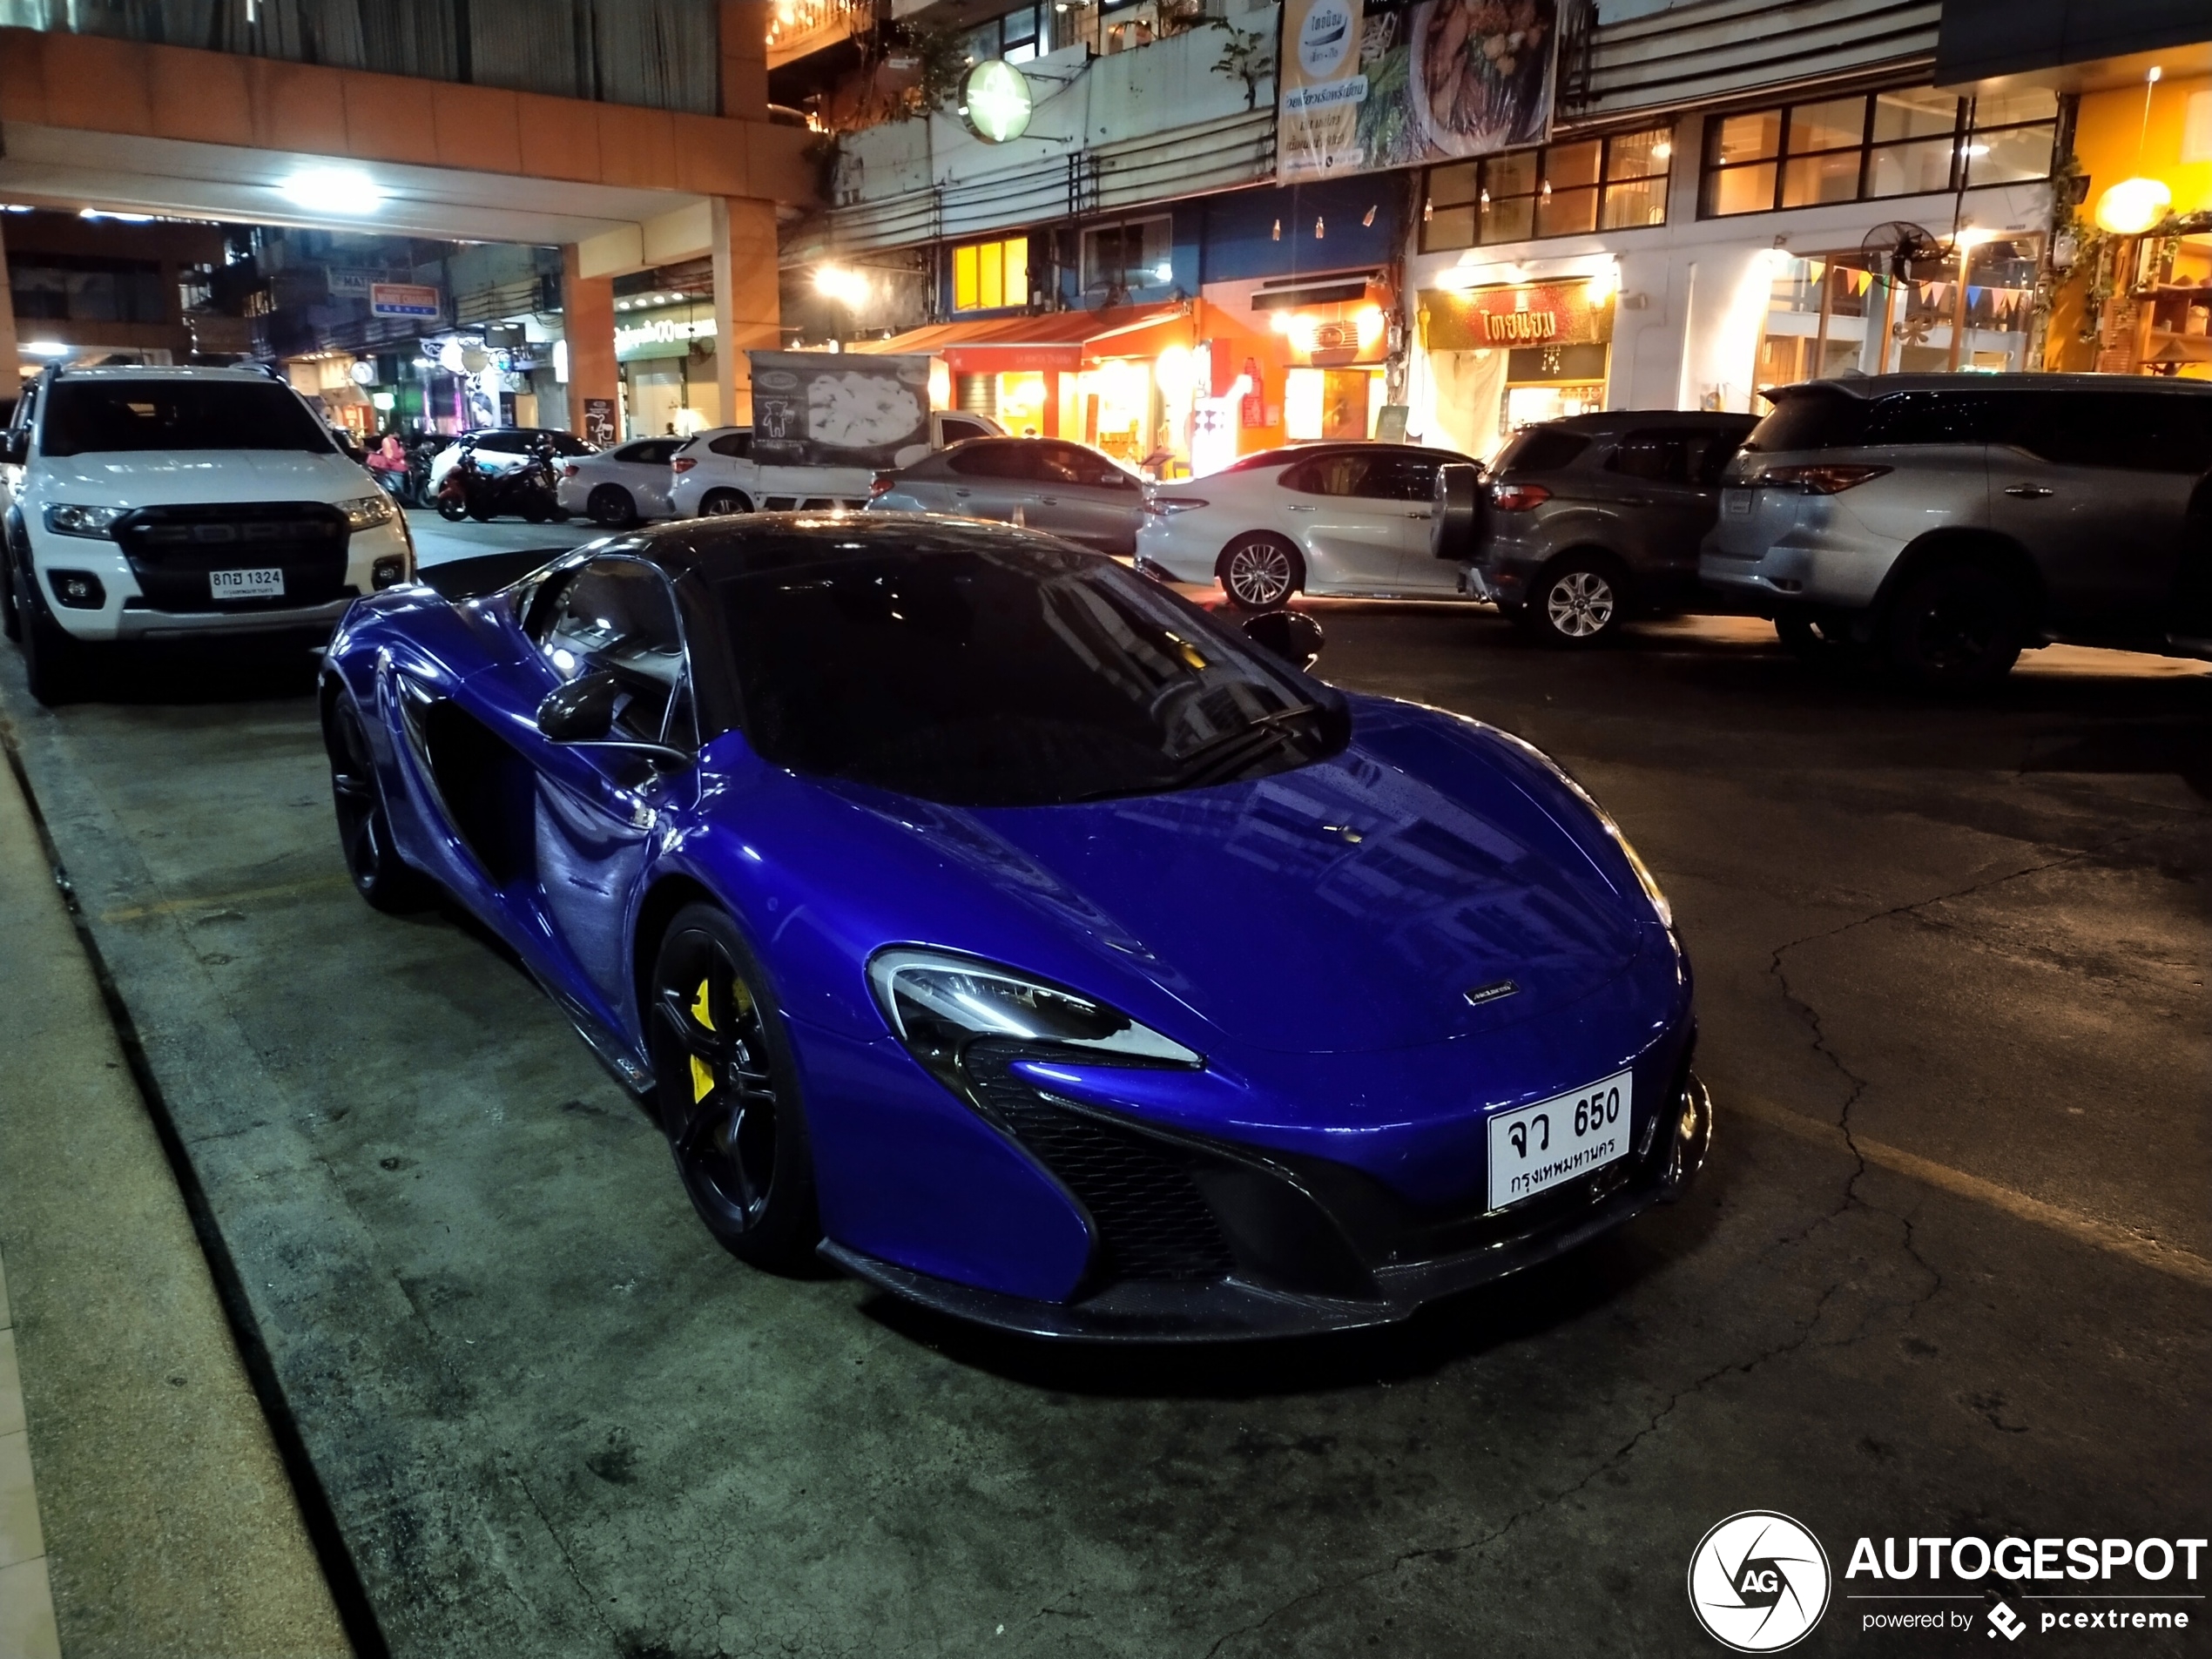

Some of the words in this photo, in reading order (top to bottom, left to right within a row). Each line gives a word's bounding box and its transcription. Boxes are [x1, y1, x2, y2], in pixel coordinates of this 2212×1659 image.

[247, 570, 280, 584] 1324
[1474, 985, 1511, 1001] McLaren
[1507, 1114, 1549, 1159] จว
[1574, 1086, 1620, 1136] 650
[1510, 1137, 1616, 1192] กรุงเทพมหานคร
